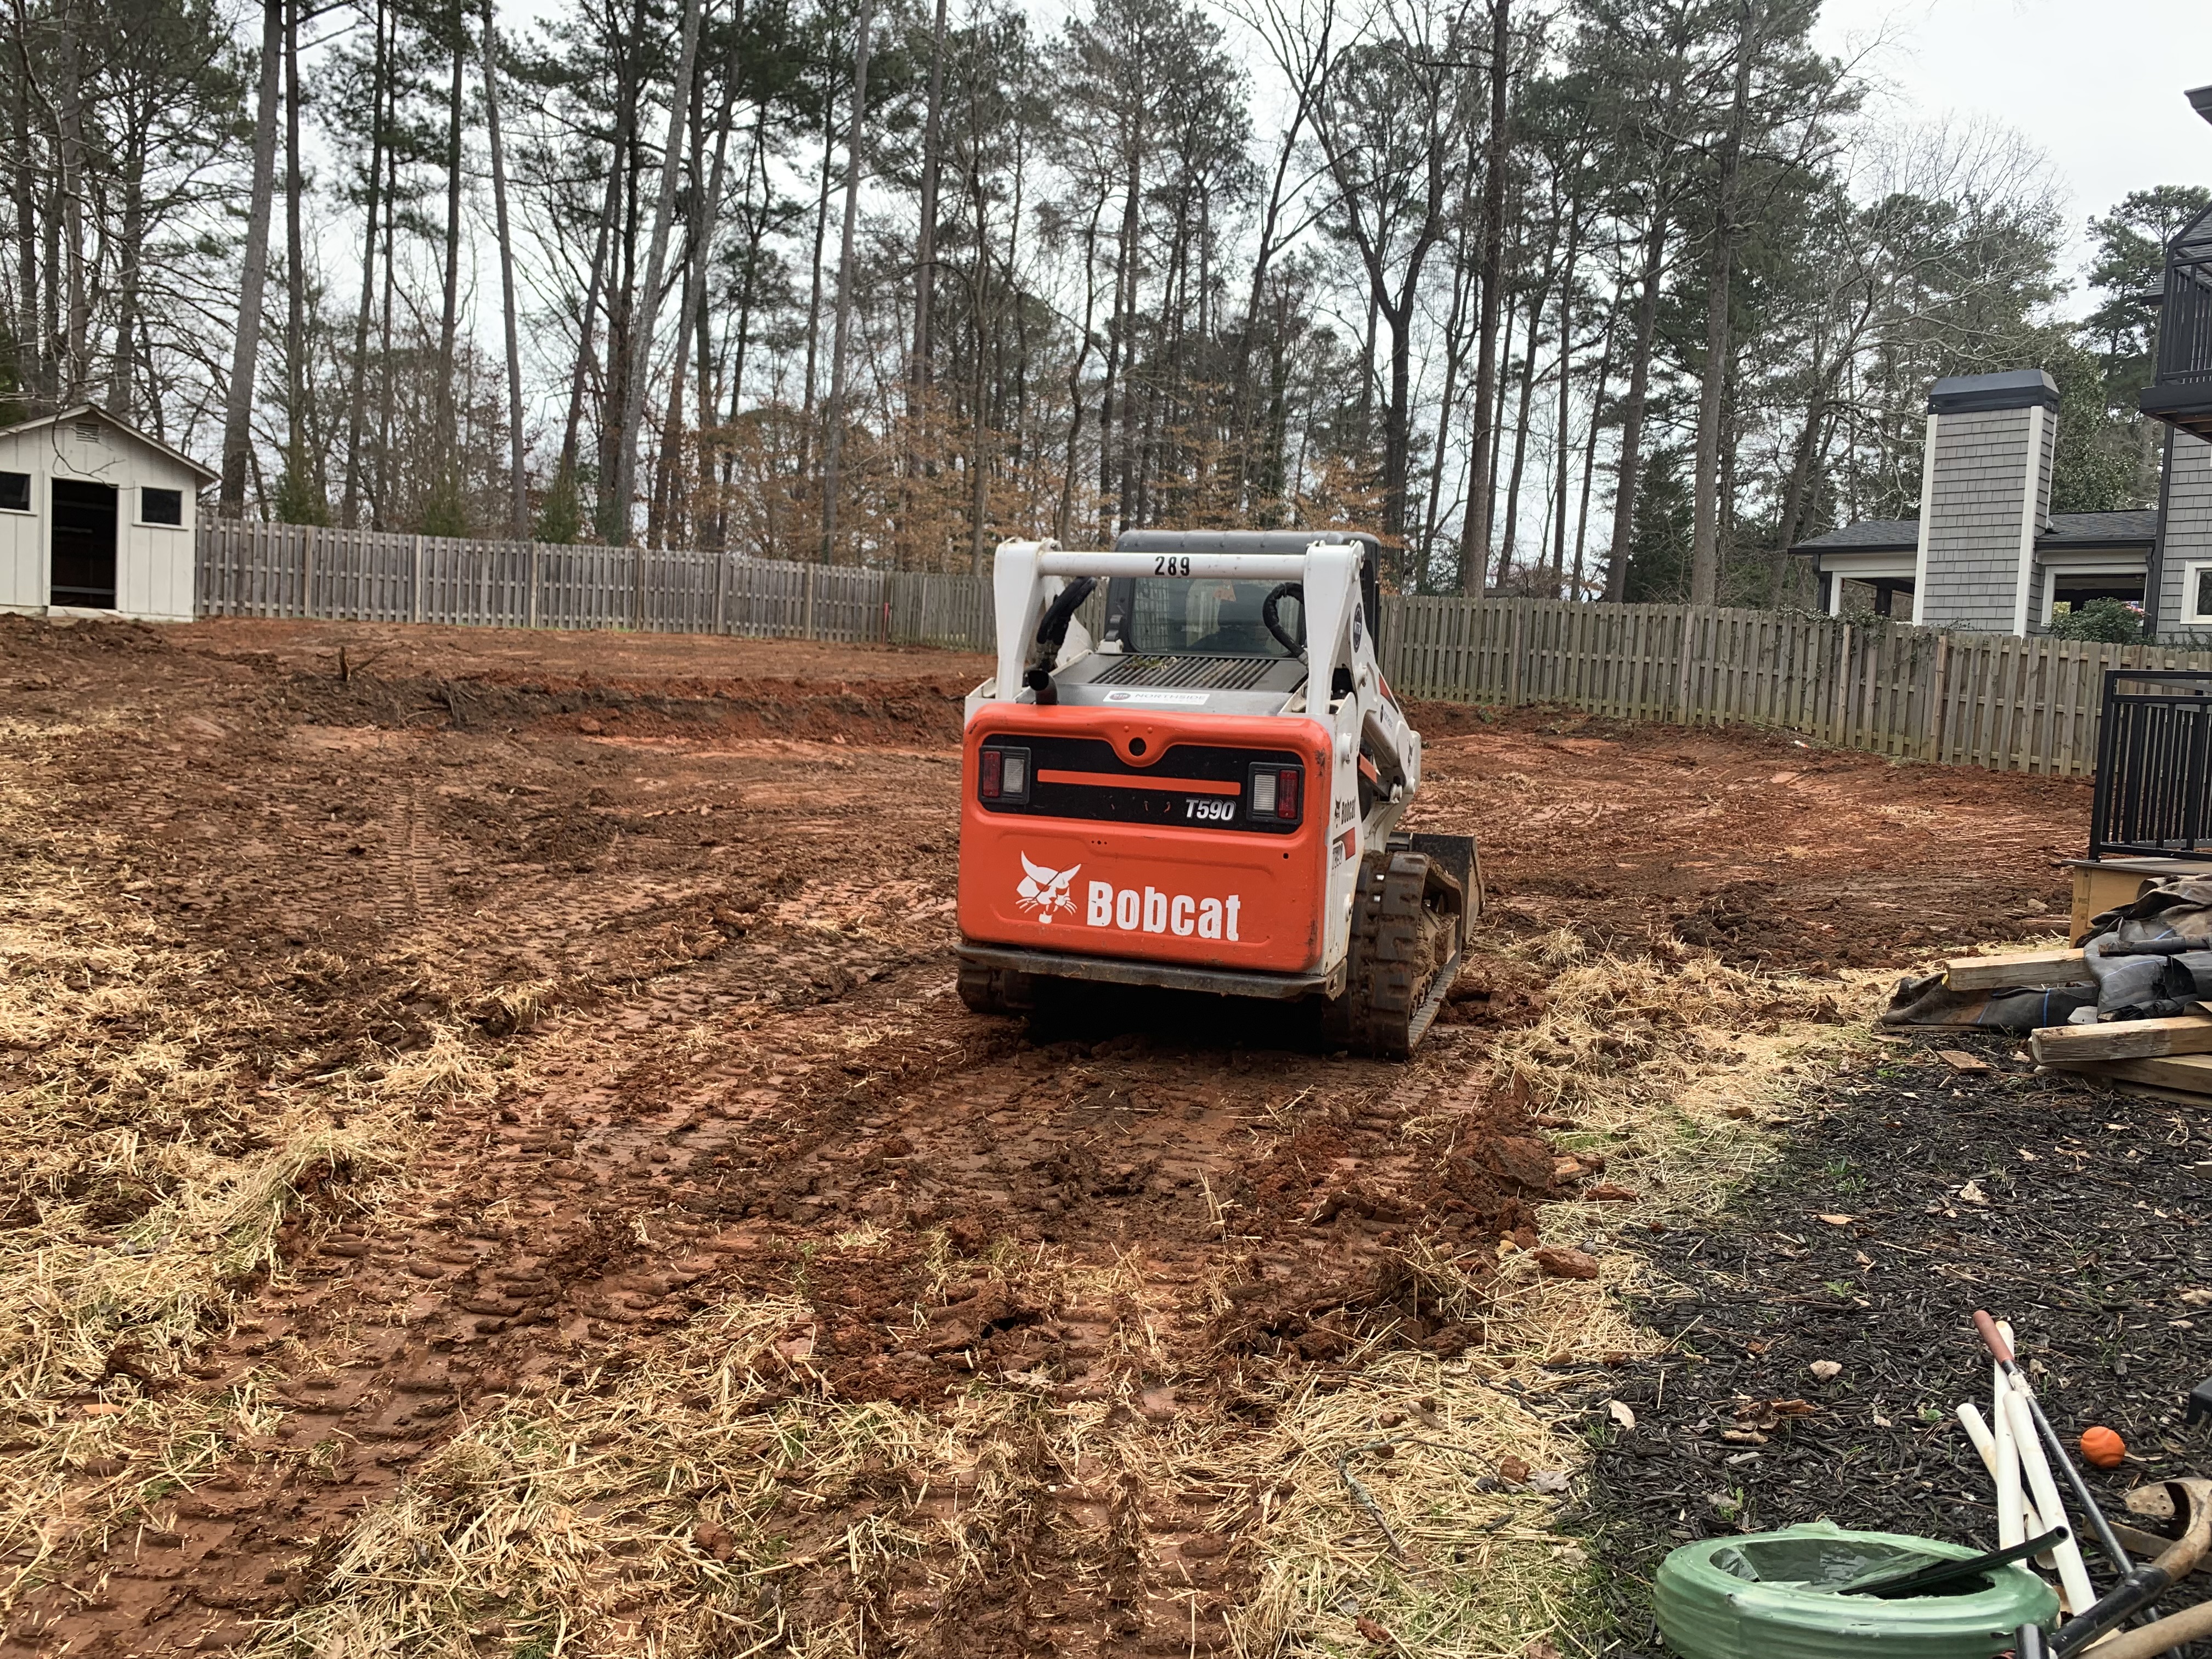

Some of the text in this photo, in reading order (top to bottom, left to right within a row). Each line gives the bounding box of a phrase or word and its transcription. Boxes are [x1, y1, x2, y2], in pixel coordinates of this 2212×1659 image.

[1154, 556, 1189, 576] 289
[1186, 798, 1236, 821] T590
[1341, 795, 1356, 825] Bobcat
[1087, 881, 1241, 941] Bobcat
